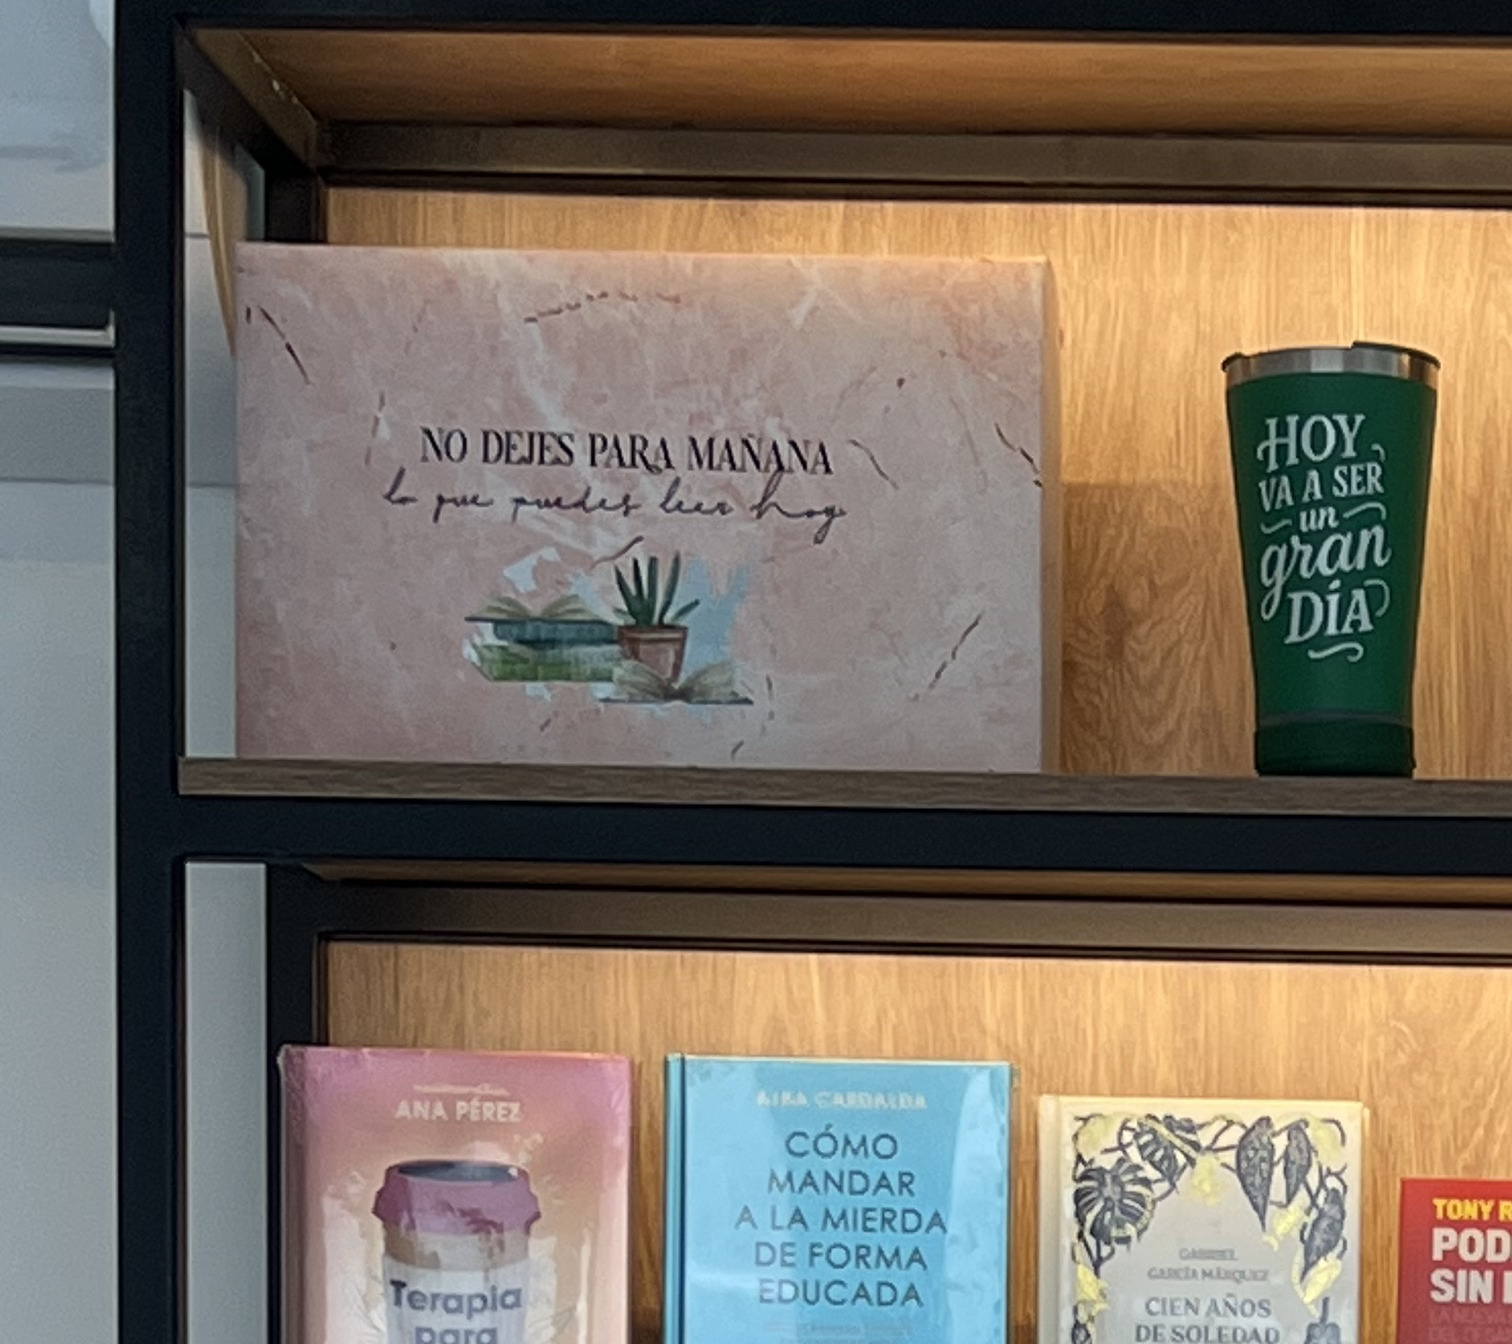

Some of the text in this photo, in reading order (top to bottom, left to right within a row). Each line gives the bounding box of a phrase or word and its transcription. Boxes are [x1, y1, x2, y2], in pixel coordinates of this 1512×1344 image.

[420, 426, 834, 475] NO DEJES PARA MAÑANA
[1257, 414, 1366, 473] HOY
[1259, 461, 1384, 511] VA A SER
[384, 469, 846, 545] lo que puedes leer hoy
[1300, 506, 1338, 531] un
[1261, 524, 1391, 621] gran
[395, 1097, 521, 1122] ANA PÉREZ
[785, 1123, 898, 1160] CÓMO
[768, 1168, 915, 1197] MANDAR
[734, 1205, 948, 1235] A LA MIERDA
[1433, 1198, 1494, 1221] TONY
[755, 1242, 928, 1271] DE FORMA
[389, 1279, 522, 1320] Terapia
[758, 1279, 924, 1307] EDUCADA
[1430, 1268, 1493, 1304] SIN
[1146, 1294, 1272, 1318] CIEN AÑOS
[1135, 1324, 1280, 1344] DE SOLEDAD
